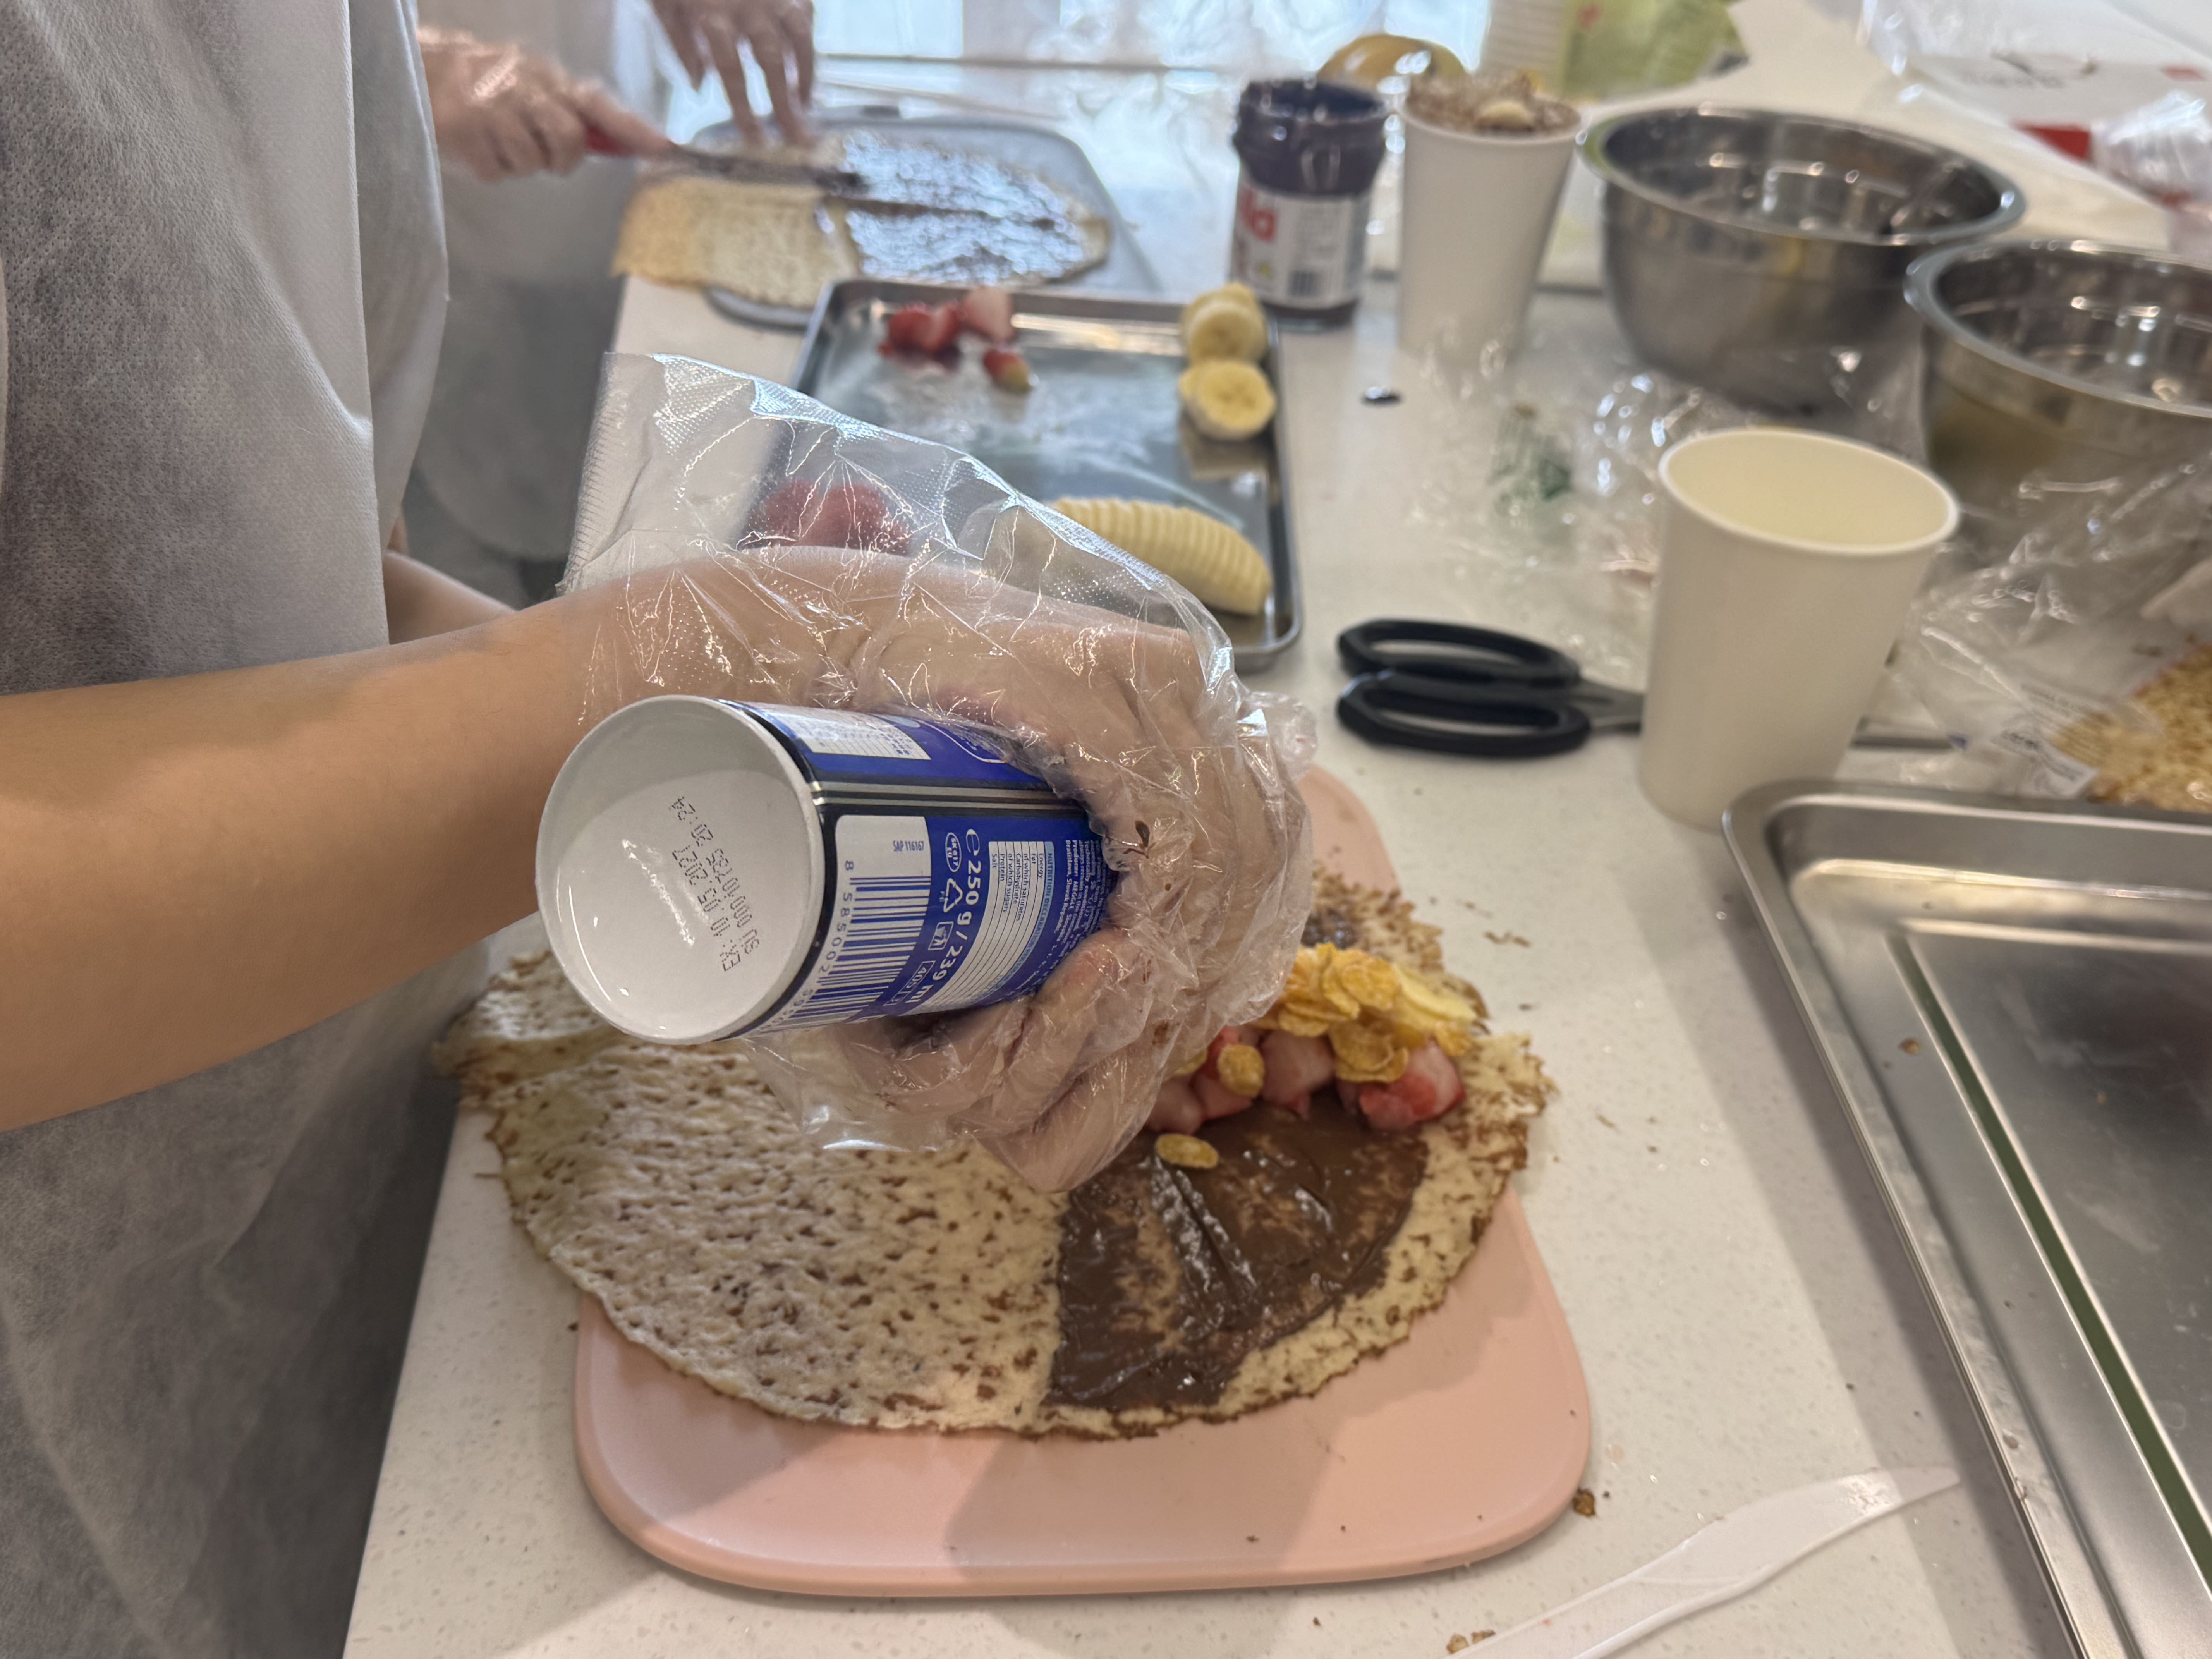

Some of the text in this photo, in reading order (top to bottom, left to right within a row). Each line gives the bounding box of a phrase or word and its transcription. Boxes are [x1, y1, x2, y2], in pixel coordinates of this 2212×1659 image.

[965, 860, 981, 905] 250
[1011, 853, 1022, 904] Carbohydrate
[1045, 853, 1053, 896] NUTRITION
[957, 911, 972, 925] g
[932, 945, 963, 981] 239
